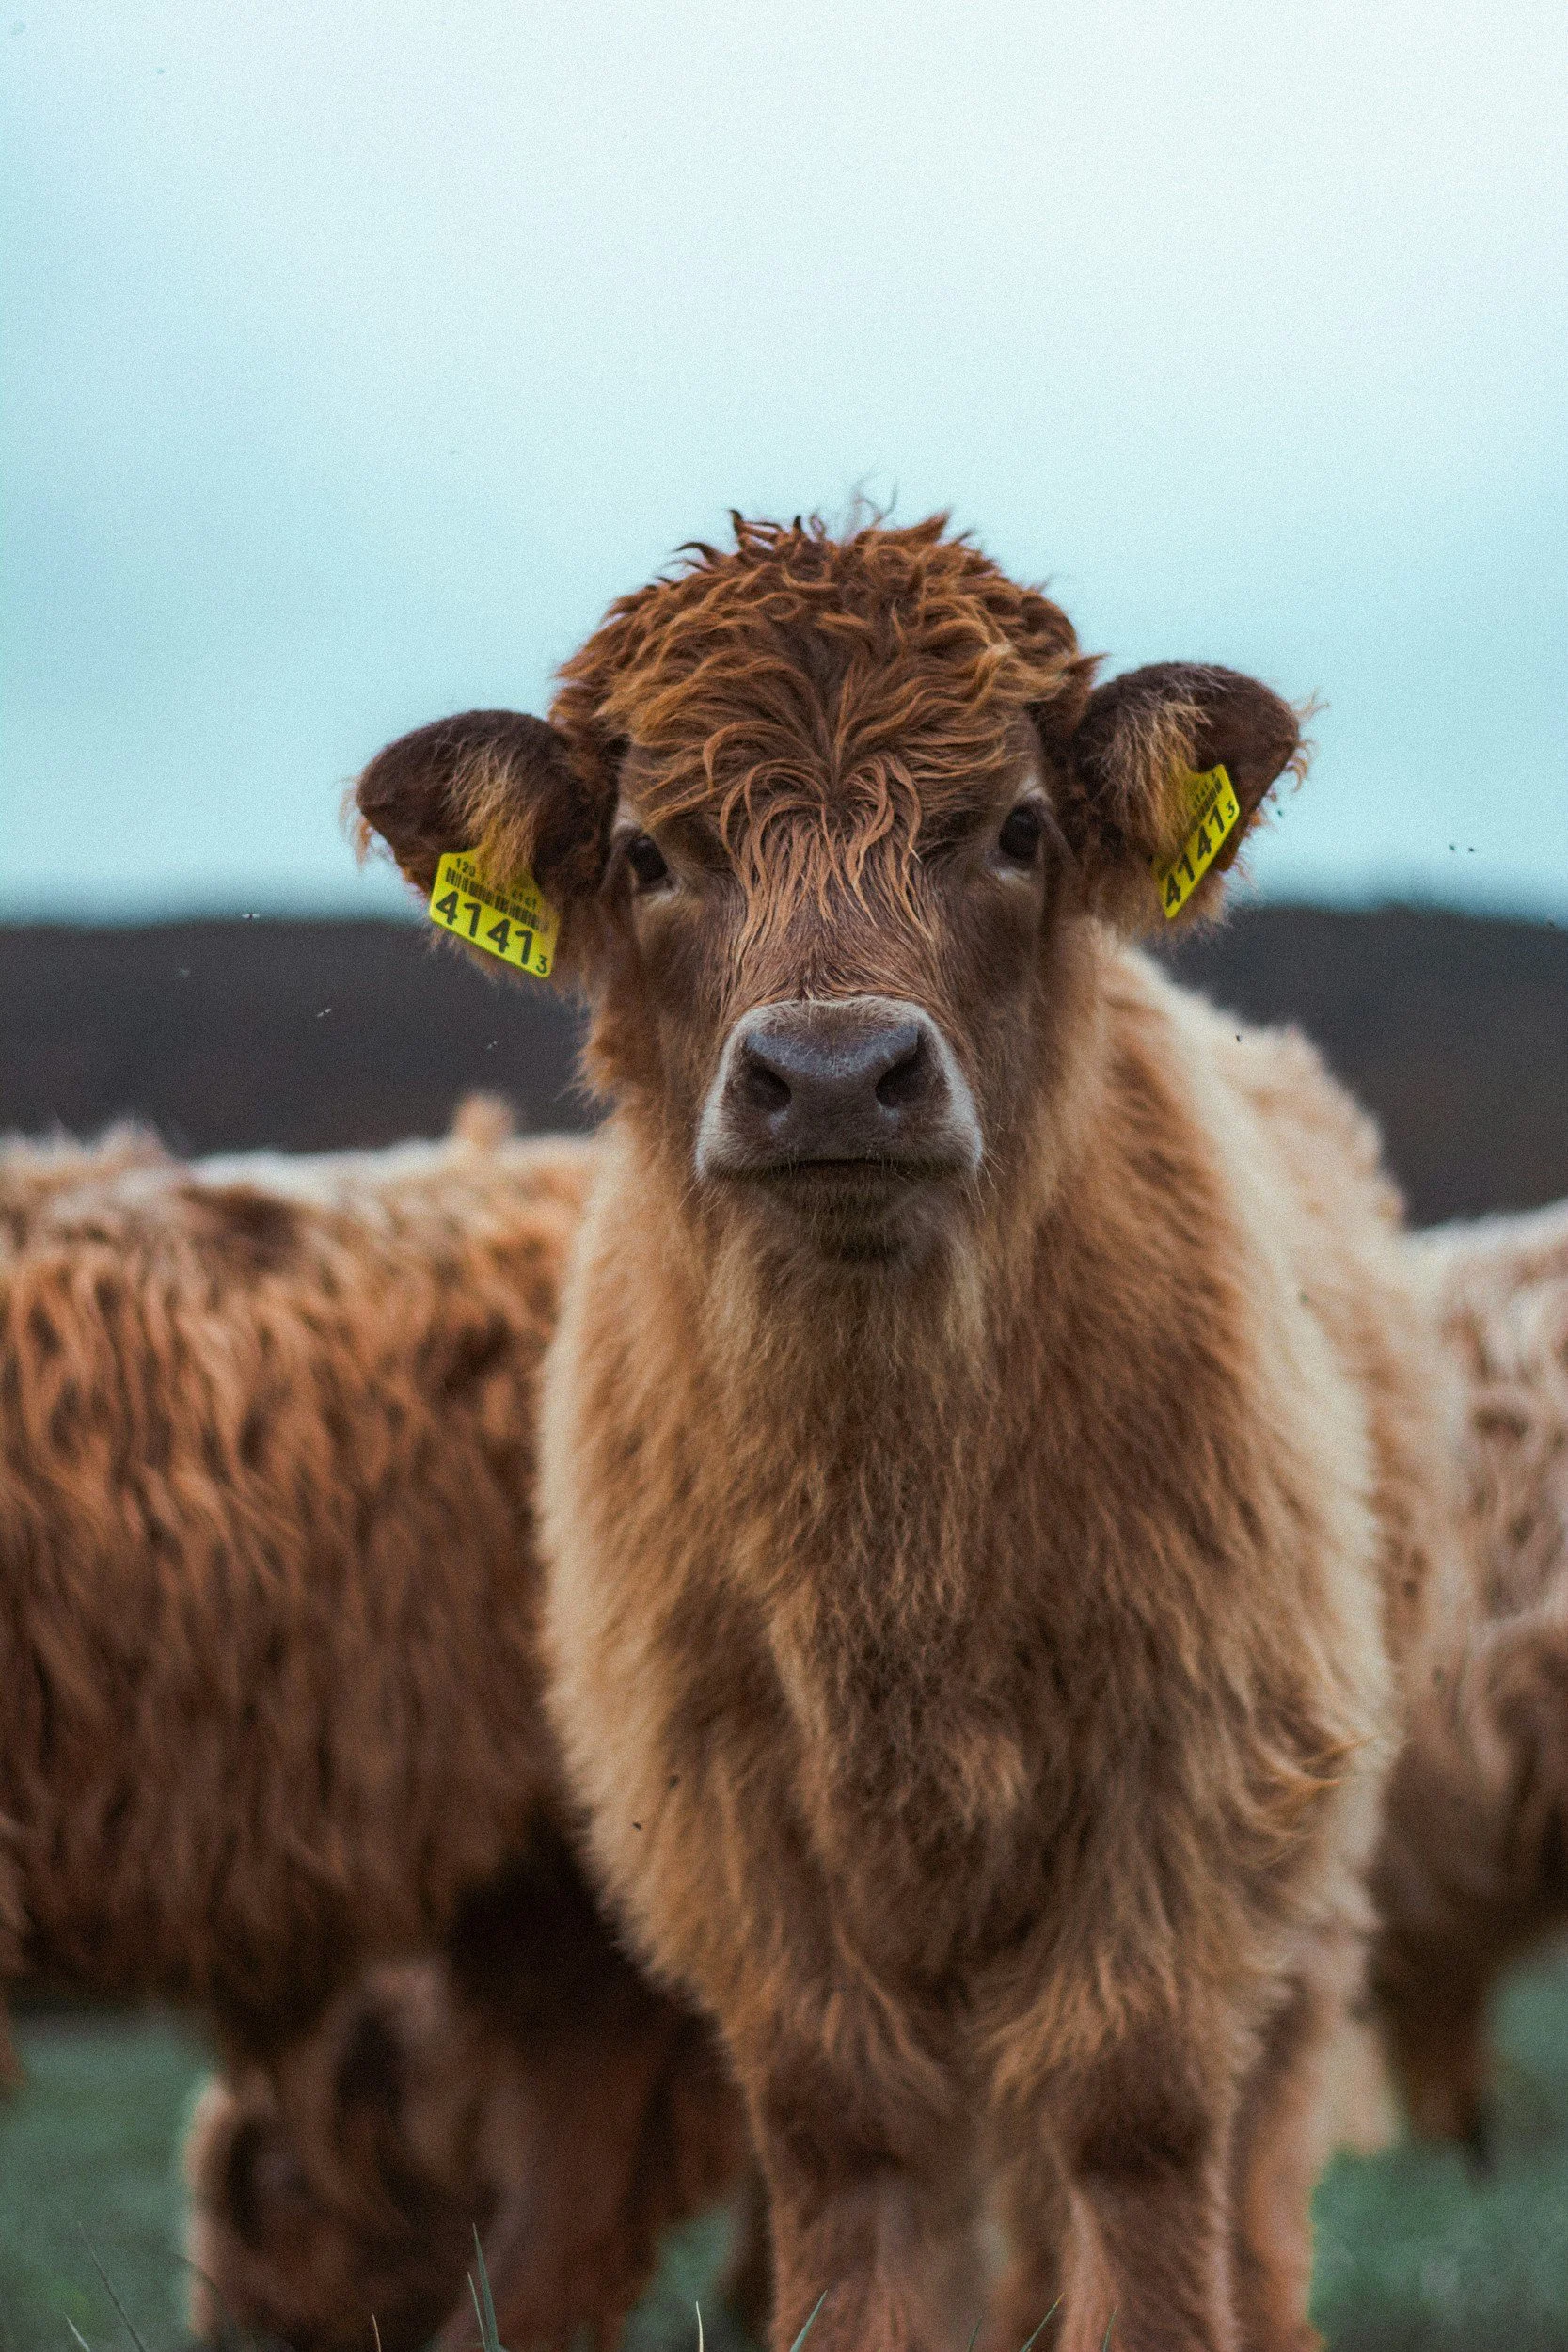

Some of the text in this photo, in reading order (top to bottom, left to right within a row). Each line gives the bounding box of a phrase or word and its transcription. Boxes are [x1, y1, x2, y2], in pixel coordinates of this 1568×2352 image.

[1165, 805, 1226, 908] 4141
[1226, 800, 1236, 819] 3
[436, 891, 548, 974] 4141 3
